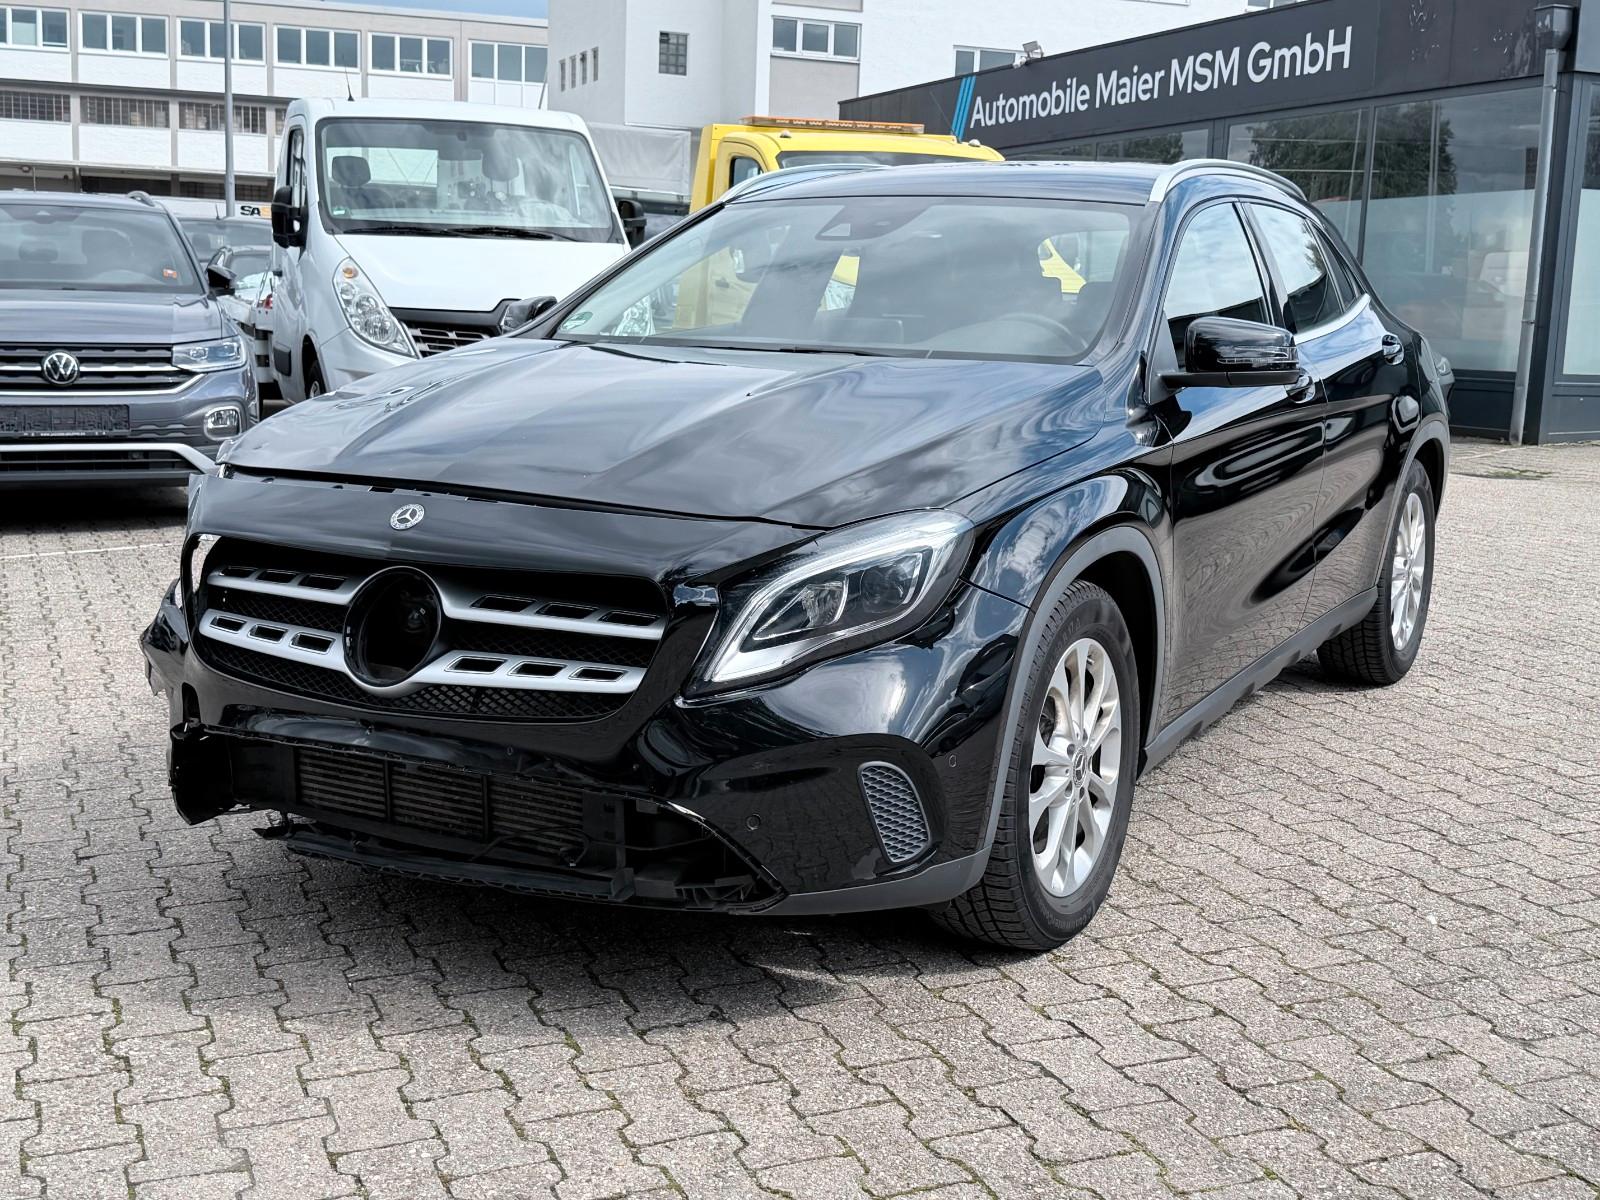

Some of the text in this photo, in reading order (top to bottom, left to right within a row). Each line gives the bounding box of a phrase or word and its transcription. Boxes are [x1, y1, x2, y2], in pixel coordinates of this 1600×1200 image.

[970, 26, 1352, 128] Automobile Maier MSM GmbH
